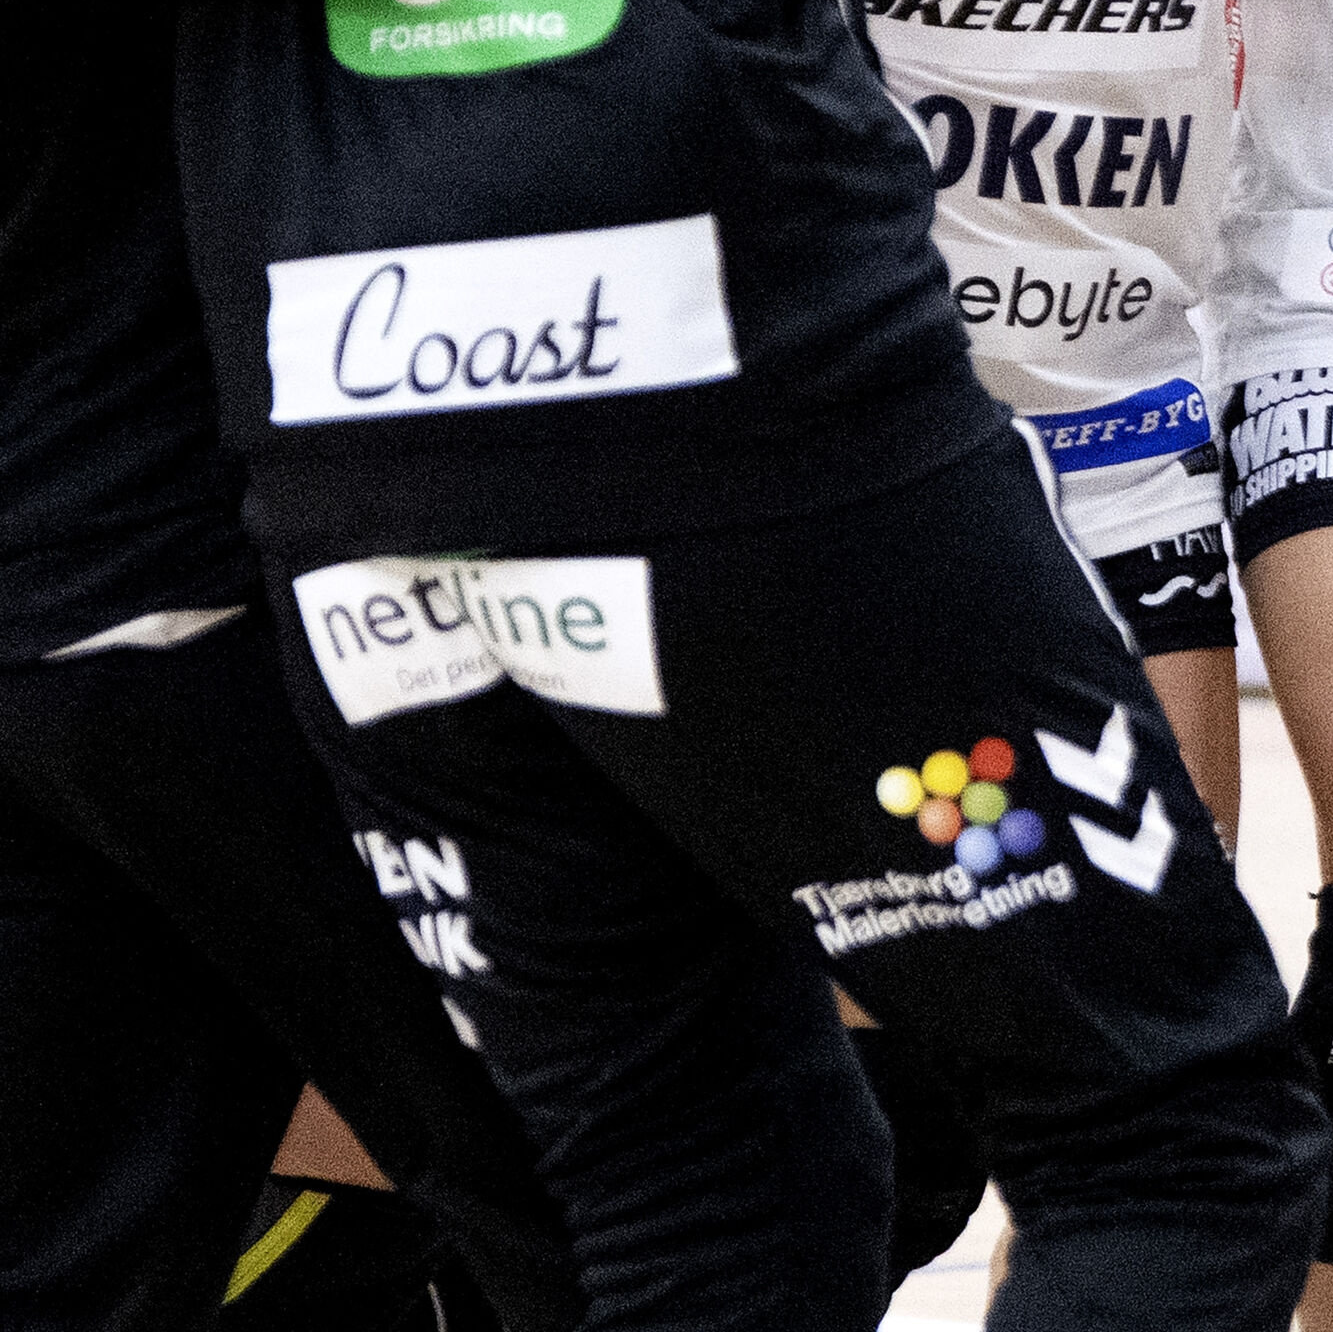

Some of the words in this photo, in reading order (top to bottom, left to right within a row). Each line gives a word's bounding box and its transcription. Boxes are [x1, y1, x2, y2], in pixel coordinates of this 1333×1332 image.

[369, 11, 567, 54] FORSIKRING
[911, 94, 1192, 208] OKKEN
[333, 262, 621, 399] Coast
[953, 267, 1152, 340] ebyte
[1043, 392, 1203, 451] EFF-BYG
[320, 568, 606, 660] netline
